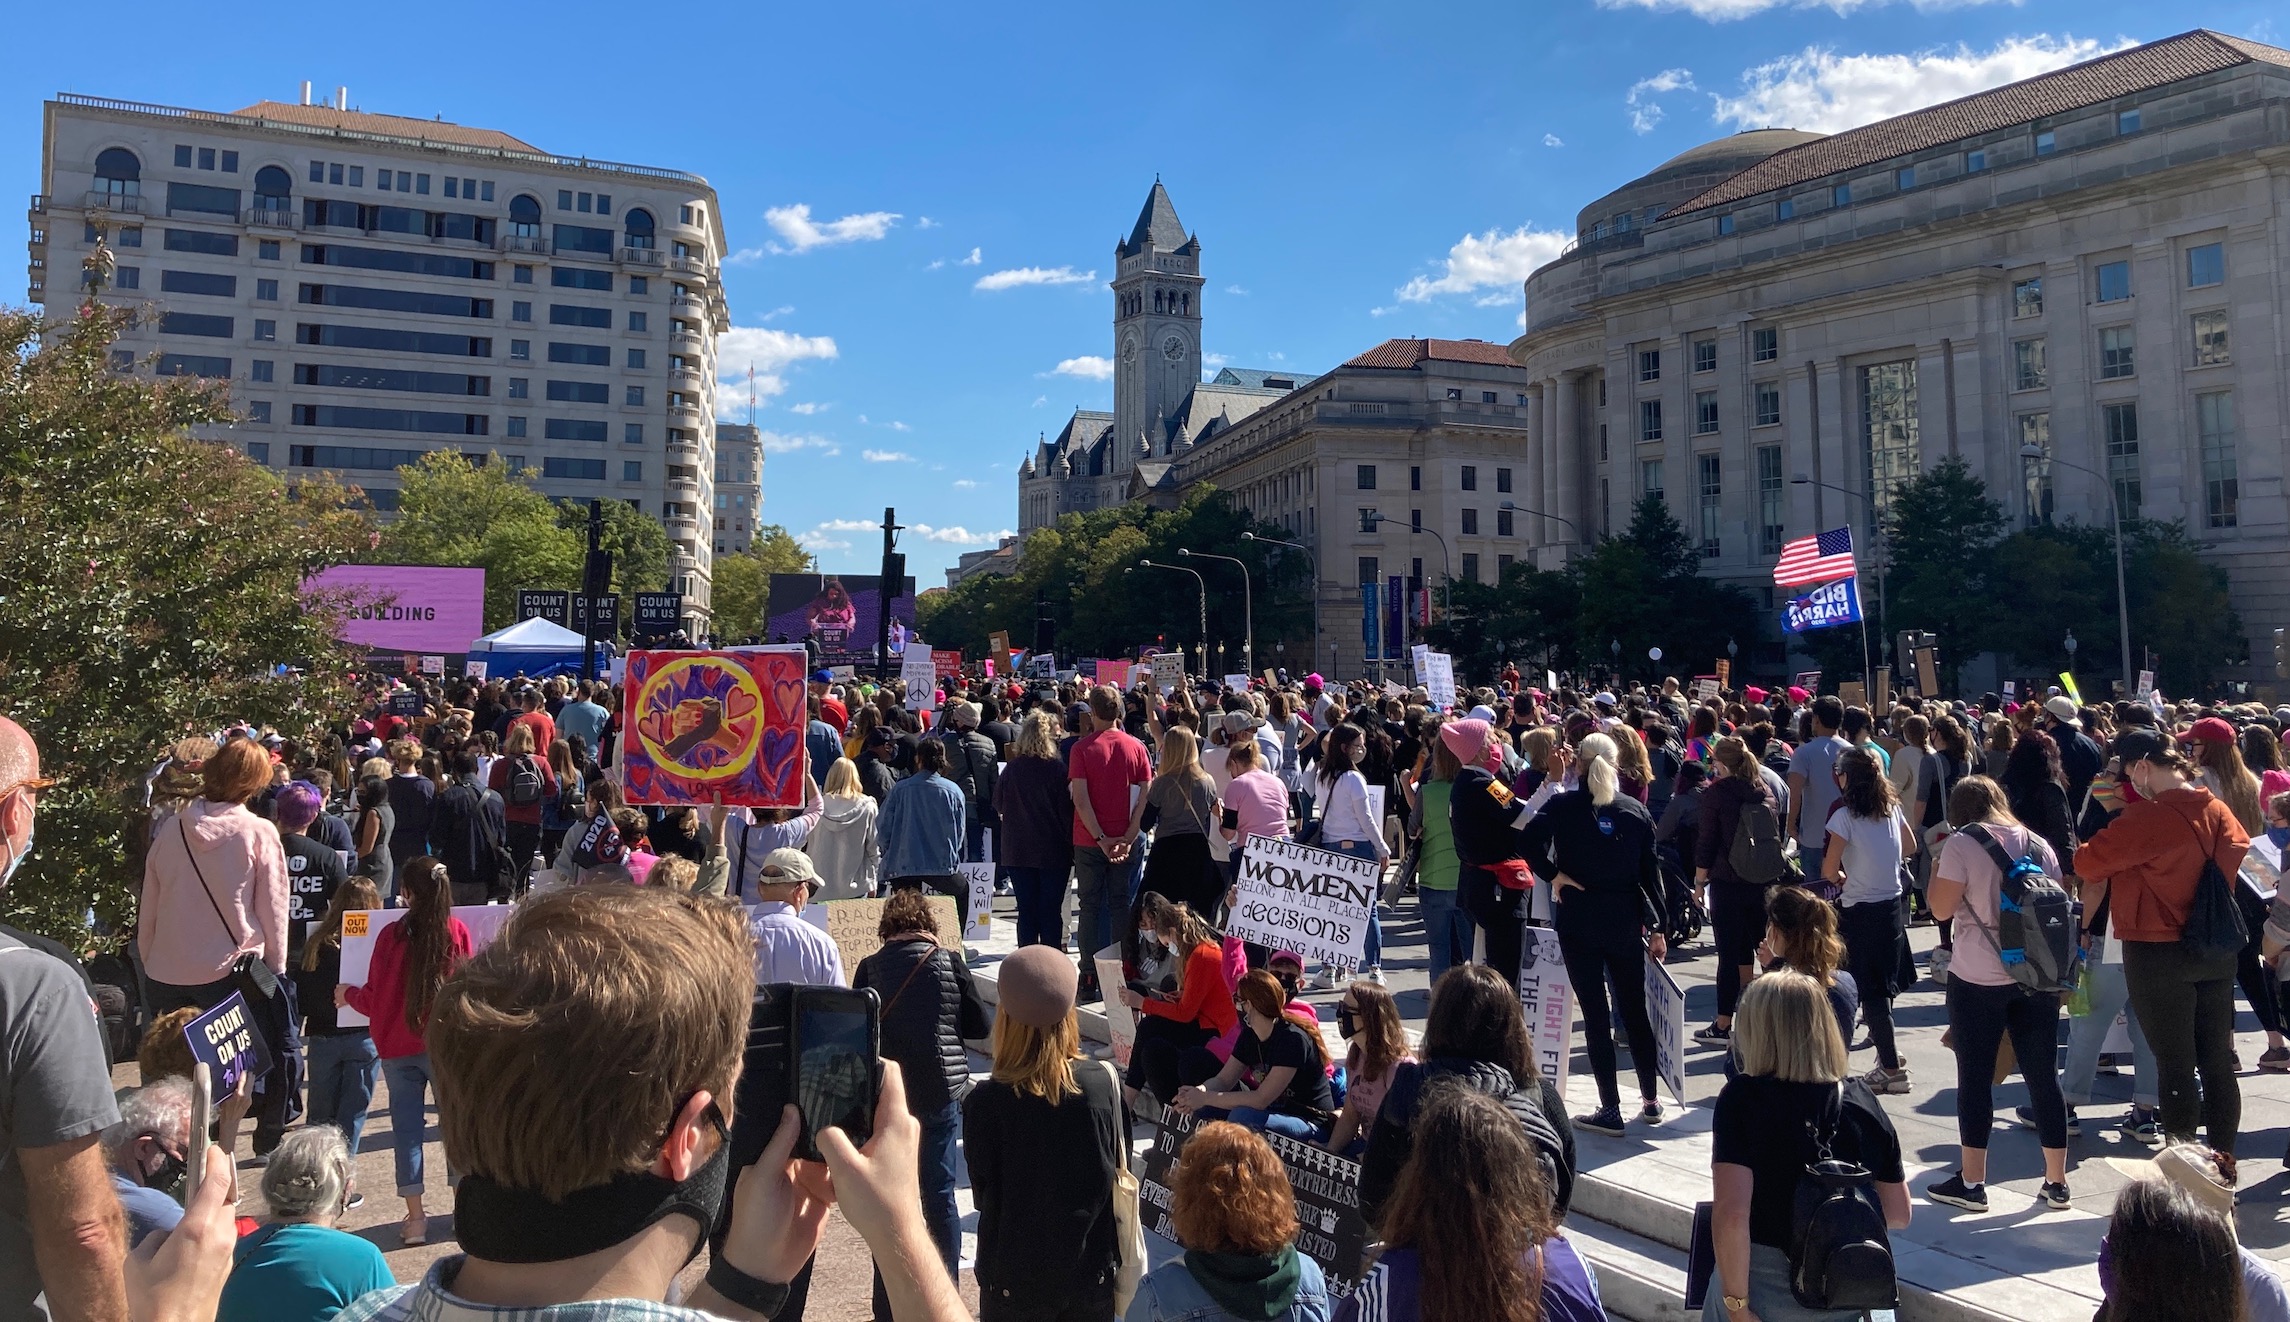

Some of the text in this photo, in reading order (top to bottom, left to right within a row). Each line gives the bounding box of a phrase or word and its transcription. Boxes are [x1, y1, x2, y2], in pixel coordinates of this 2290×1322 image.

[524, 595, 565, 606] COUNT
[526, 607, 561, 617] ON US
[598, 610, 612, 618] US
[639, 597, 678, 607] COUNT
[642, 608, 675, 618] ON US
[580, 814, 607, 852] 2020
[604, 833, 620, 856] 45
[288, 876, 323, 892] TICE
[976, 886, 986, 895] a
[1243, 855, 1374, 908] WOMEN
[974, 894, 992, 909] will
[1237, 878, 1369, 922] BELONG IN ALL PLACES
[1242, 900, 1351, 945] decisions
[1226, 924, 1358, 970] ARE BEING MADE
[204, 1004, 244, 1045] COUNT
[1544, 984, 1565, 1042] FIGHT
[217, 1029, 252, 1065] ON US
[1160, 1103, 1173, 1126] IT
[1177, 1112, 1192, 1133] IS
[1160, 1131, 1174, 1154] TO
[1296, 1200, 1320, 1227] SHE
[1297, 1229, 1337, 1262] ISTED
